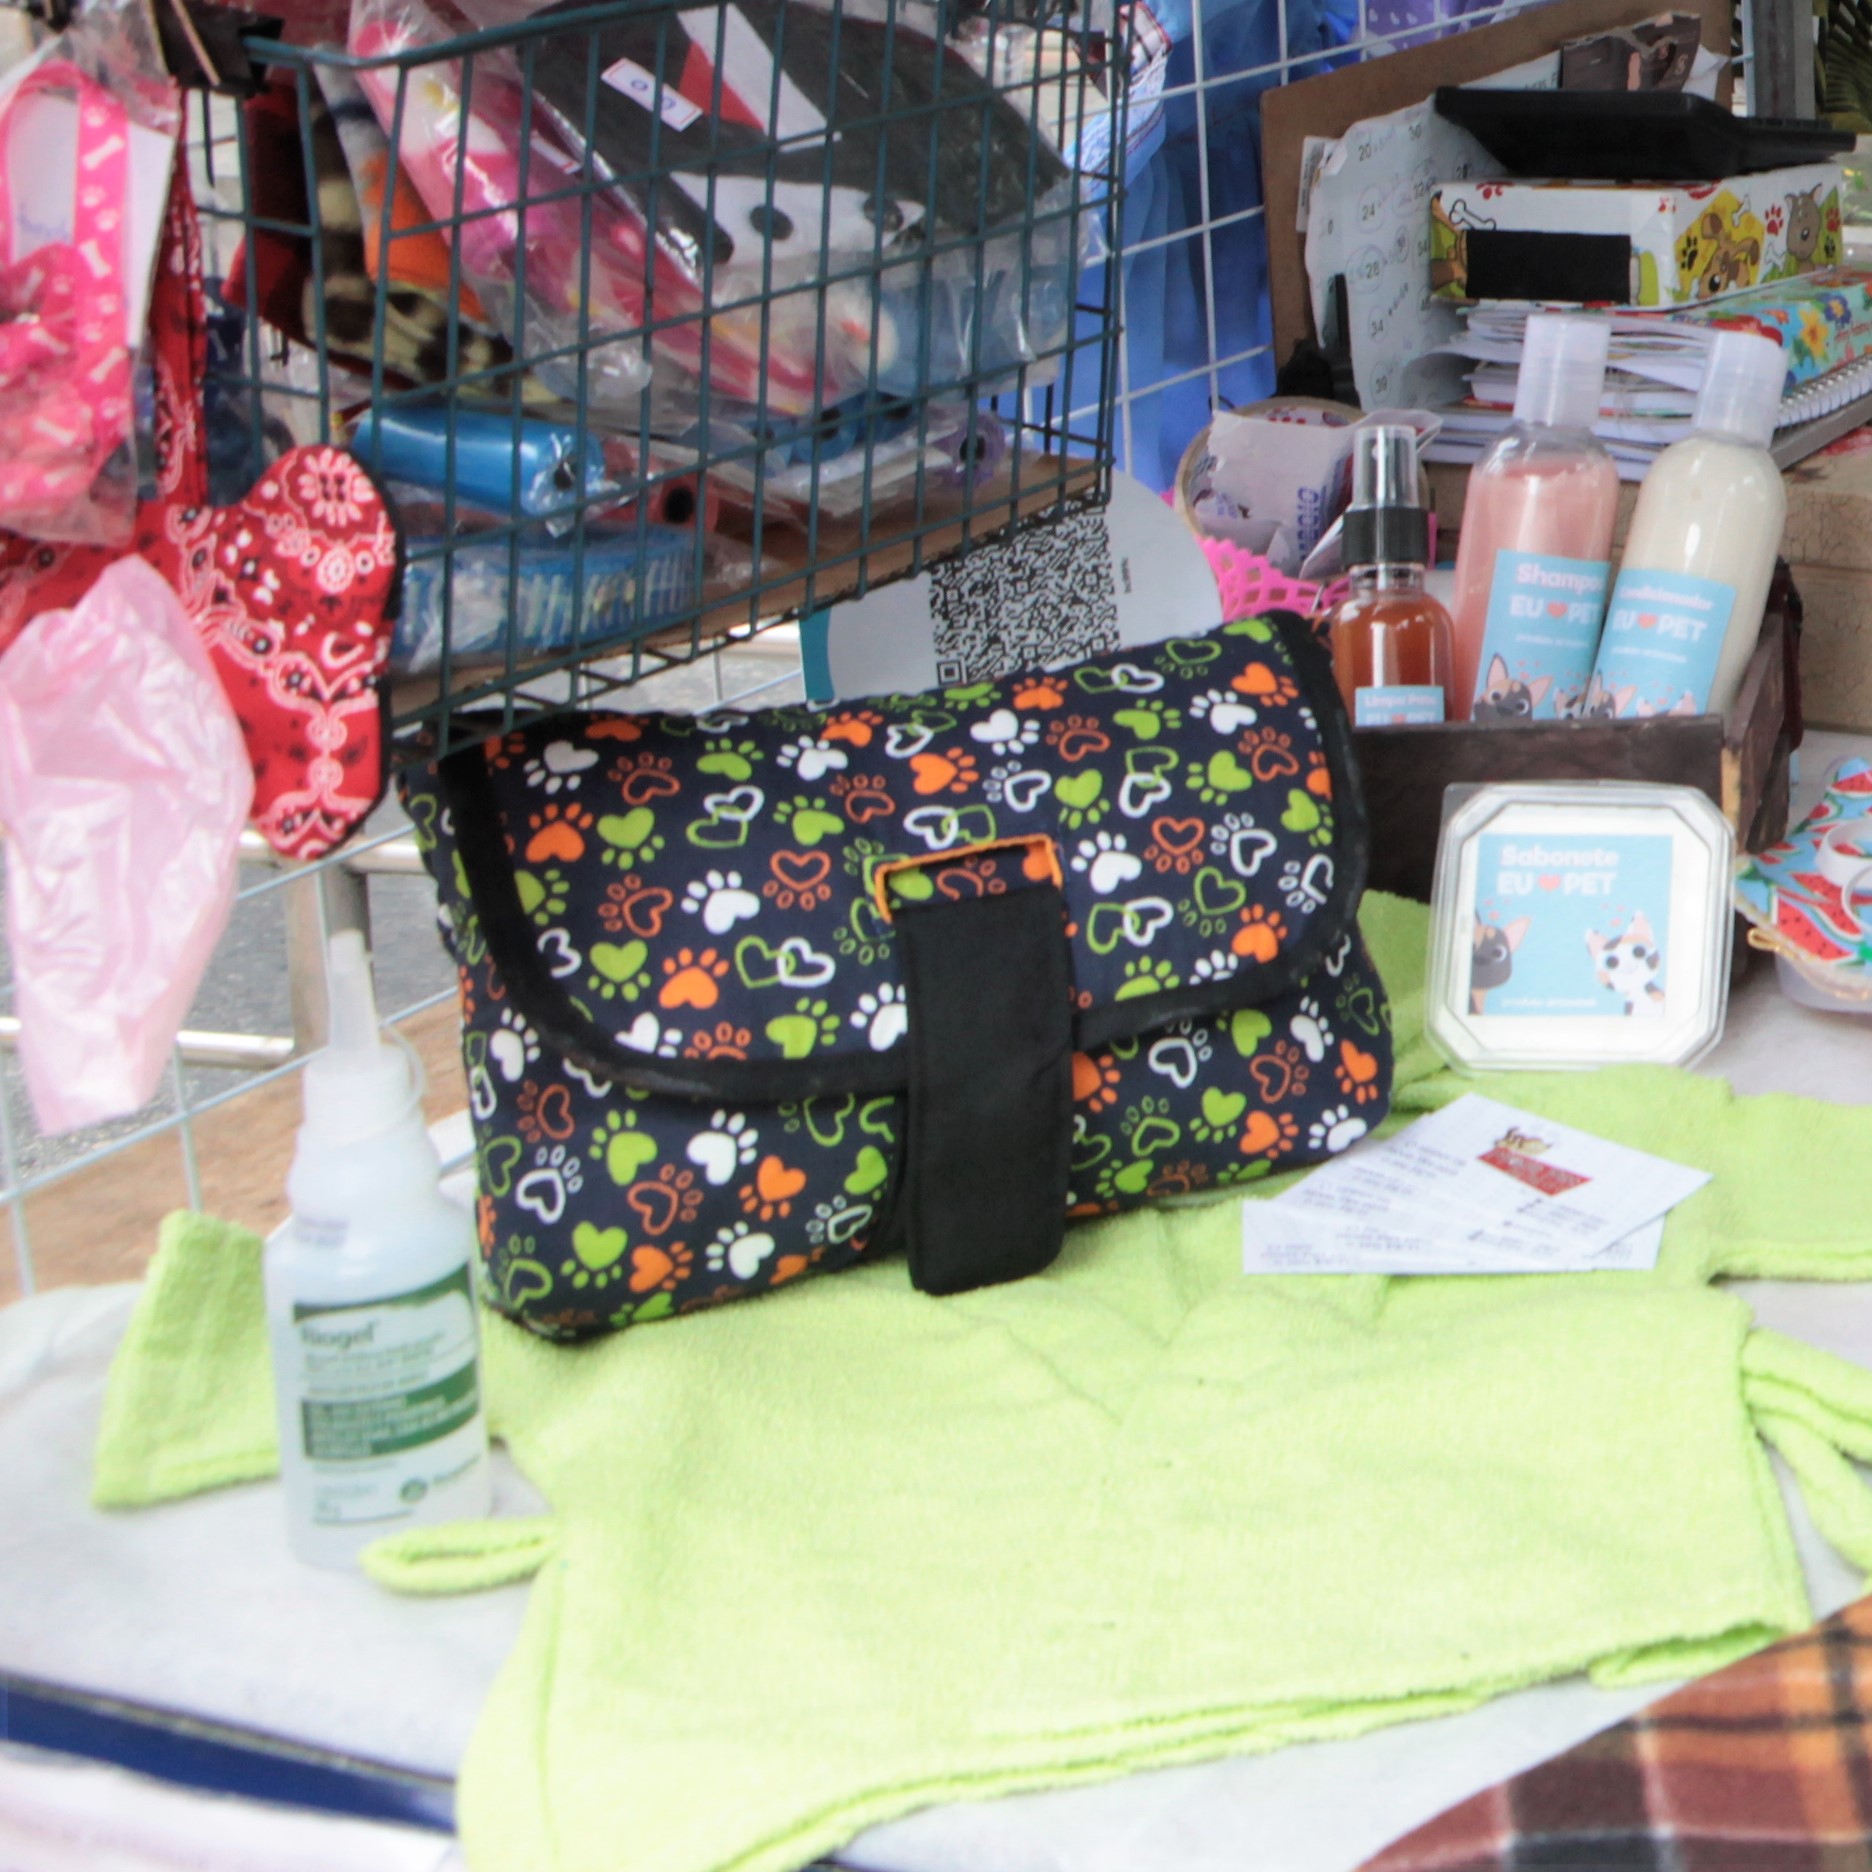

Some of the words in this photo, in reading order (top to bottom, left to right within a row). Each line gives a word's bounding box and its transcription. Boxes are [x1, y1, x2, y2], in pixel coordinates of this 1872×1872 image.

[1509, 594, 1544, 619] EU
[1566, 602, 1602, 625] PET
[1656, 614, 1708, 642] PET
[1500, 844, 1620, 868] Sabonete
[1497, 871, 1533, 895] EU
[1563, 871, 1617, 895] PET
